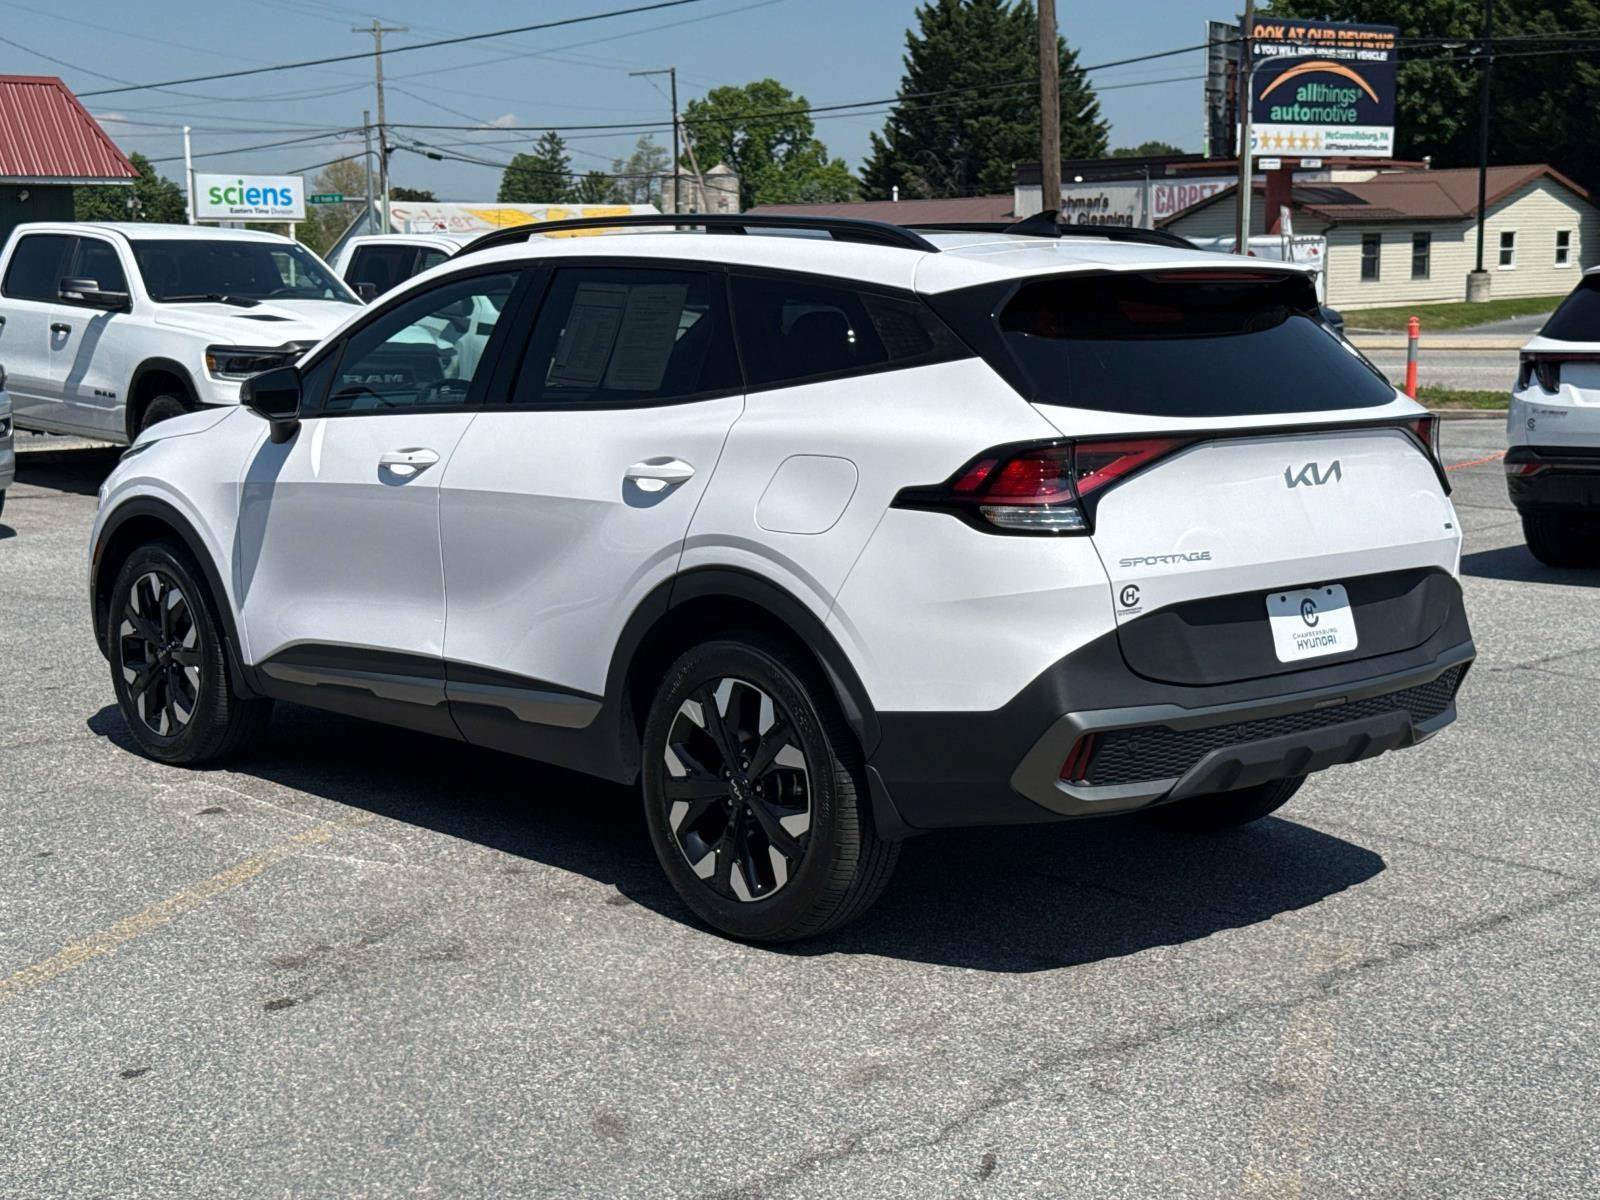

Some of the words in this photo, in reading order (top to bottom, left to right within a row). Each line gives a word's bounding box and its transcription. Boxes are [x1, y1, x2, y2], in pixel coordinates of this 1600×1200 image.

[1254, 24, 1285, 42] OOK
[1288, 26, 1306, 44] AT
[1261, 44, 1277, 55] YOU
[1279, 45, 1297, 56] WILL
[1270, 103, 1357, 122] automotive
[209, 179, 293, 206] sciens
[1078, 211, 1133, 227] Cleaning
[343, 374, 404, 384] RAM
[1119, 551, 1212, 567] SPORTAGE
[1297, 635, 1337, 650] HYUNDAI
